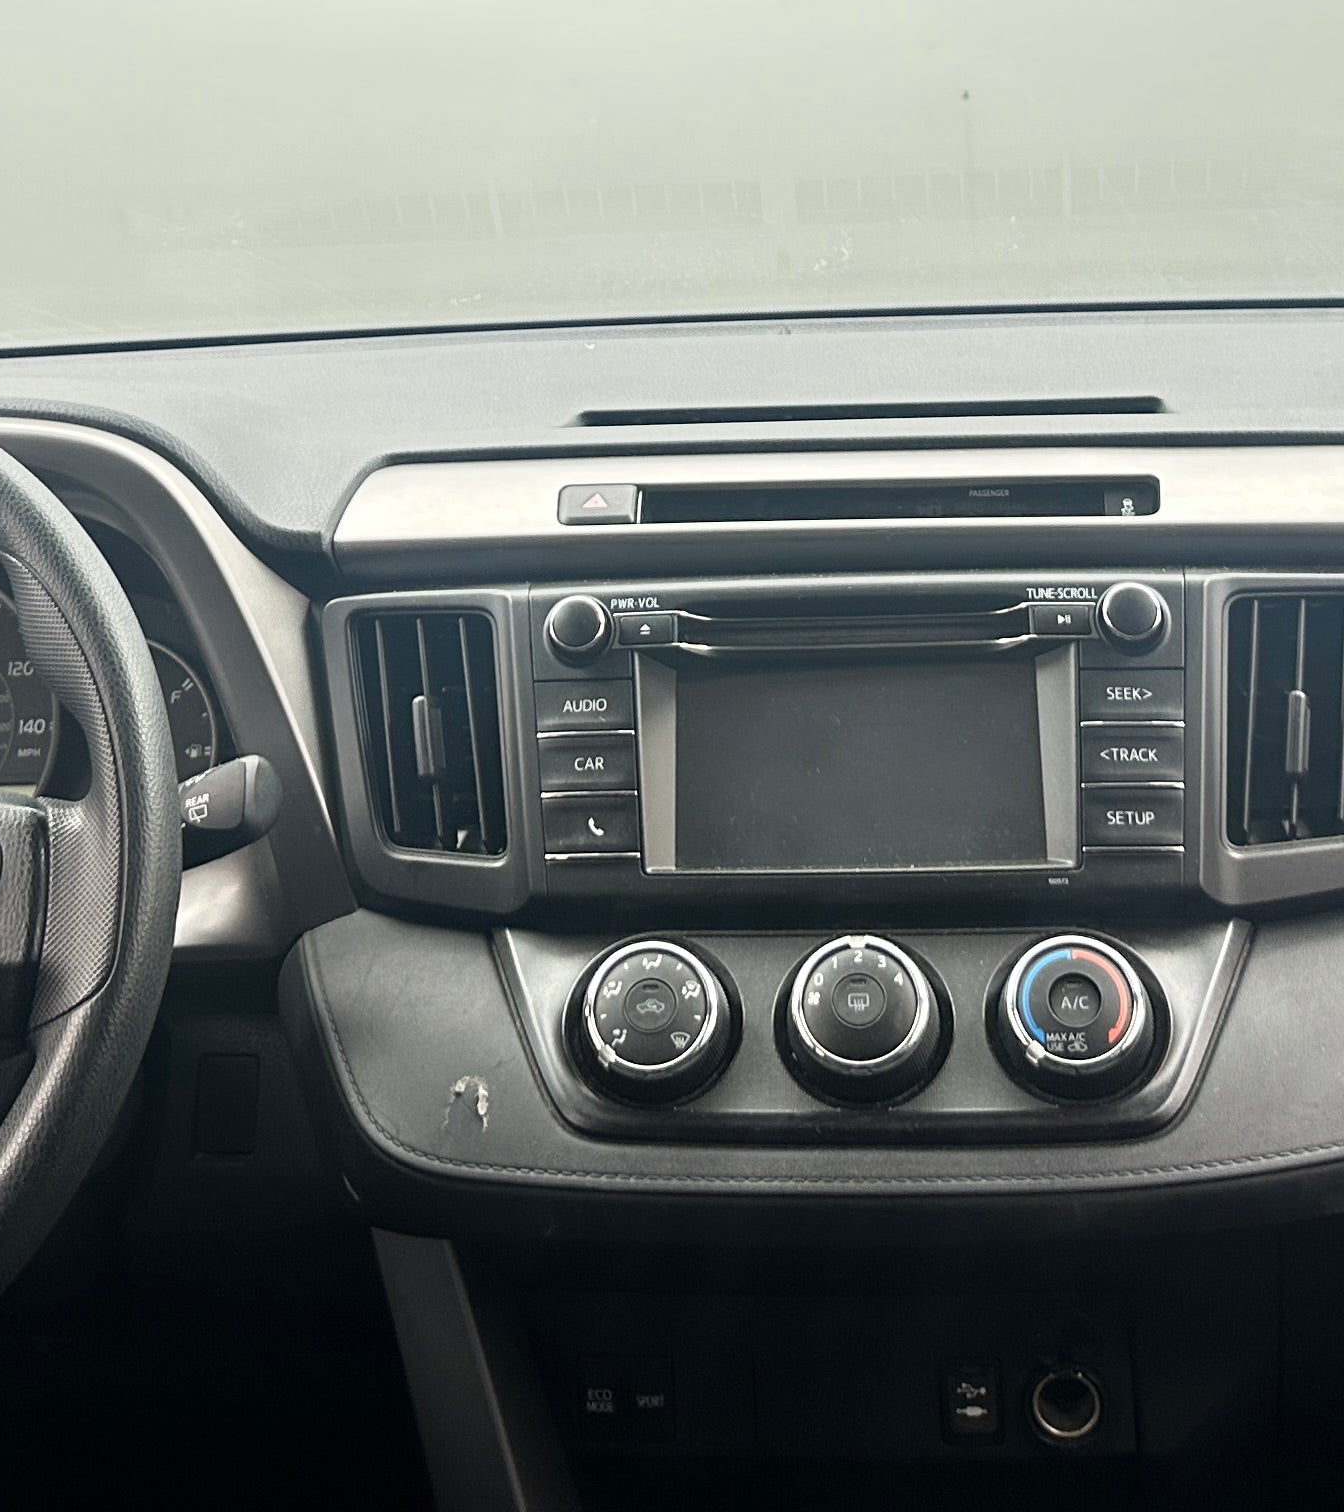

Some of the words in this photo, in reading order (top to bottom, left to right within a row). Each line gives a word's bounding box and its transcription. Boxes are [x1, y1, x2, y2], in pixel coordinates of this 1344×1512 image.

[7, 660, 35, 677] 120
[170, 690, 182, 704] F
[562, 698, 608, 713] AUDIO
[18, 718, 46, 735] 140
[17, 747, 42, 758] MPH
[573, 756, 605, 771] CAR
[184, 793, 210, 808] REAR
[1106, 810, 1156, 826] SETUP
[853, 949, 863, 963] 2
[877, 954, 887, 968] 3
[813, 972, 824, 986] 0
[892, 971, 904, 986] 4
[1060, 995, 1090, 1011] A/C
[1045, 1031, 1068, 1042] MAX
[1067, 1031, 1086, 1042] A/C
[1046, 1042, 1064, 1052] USE
